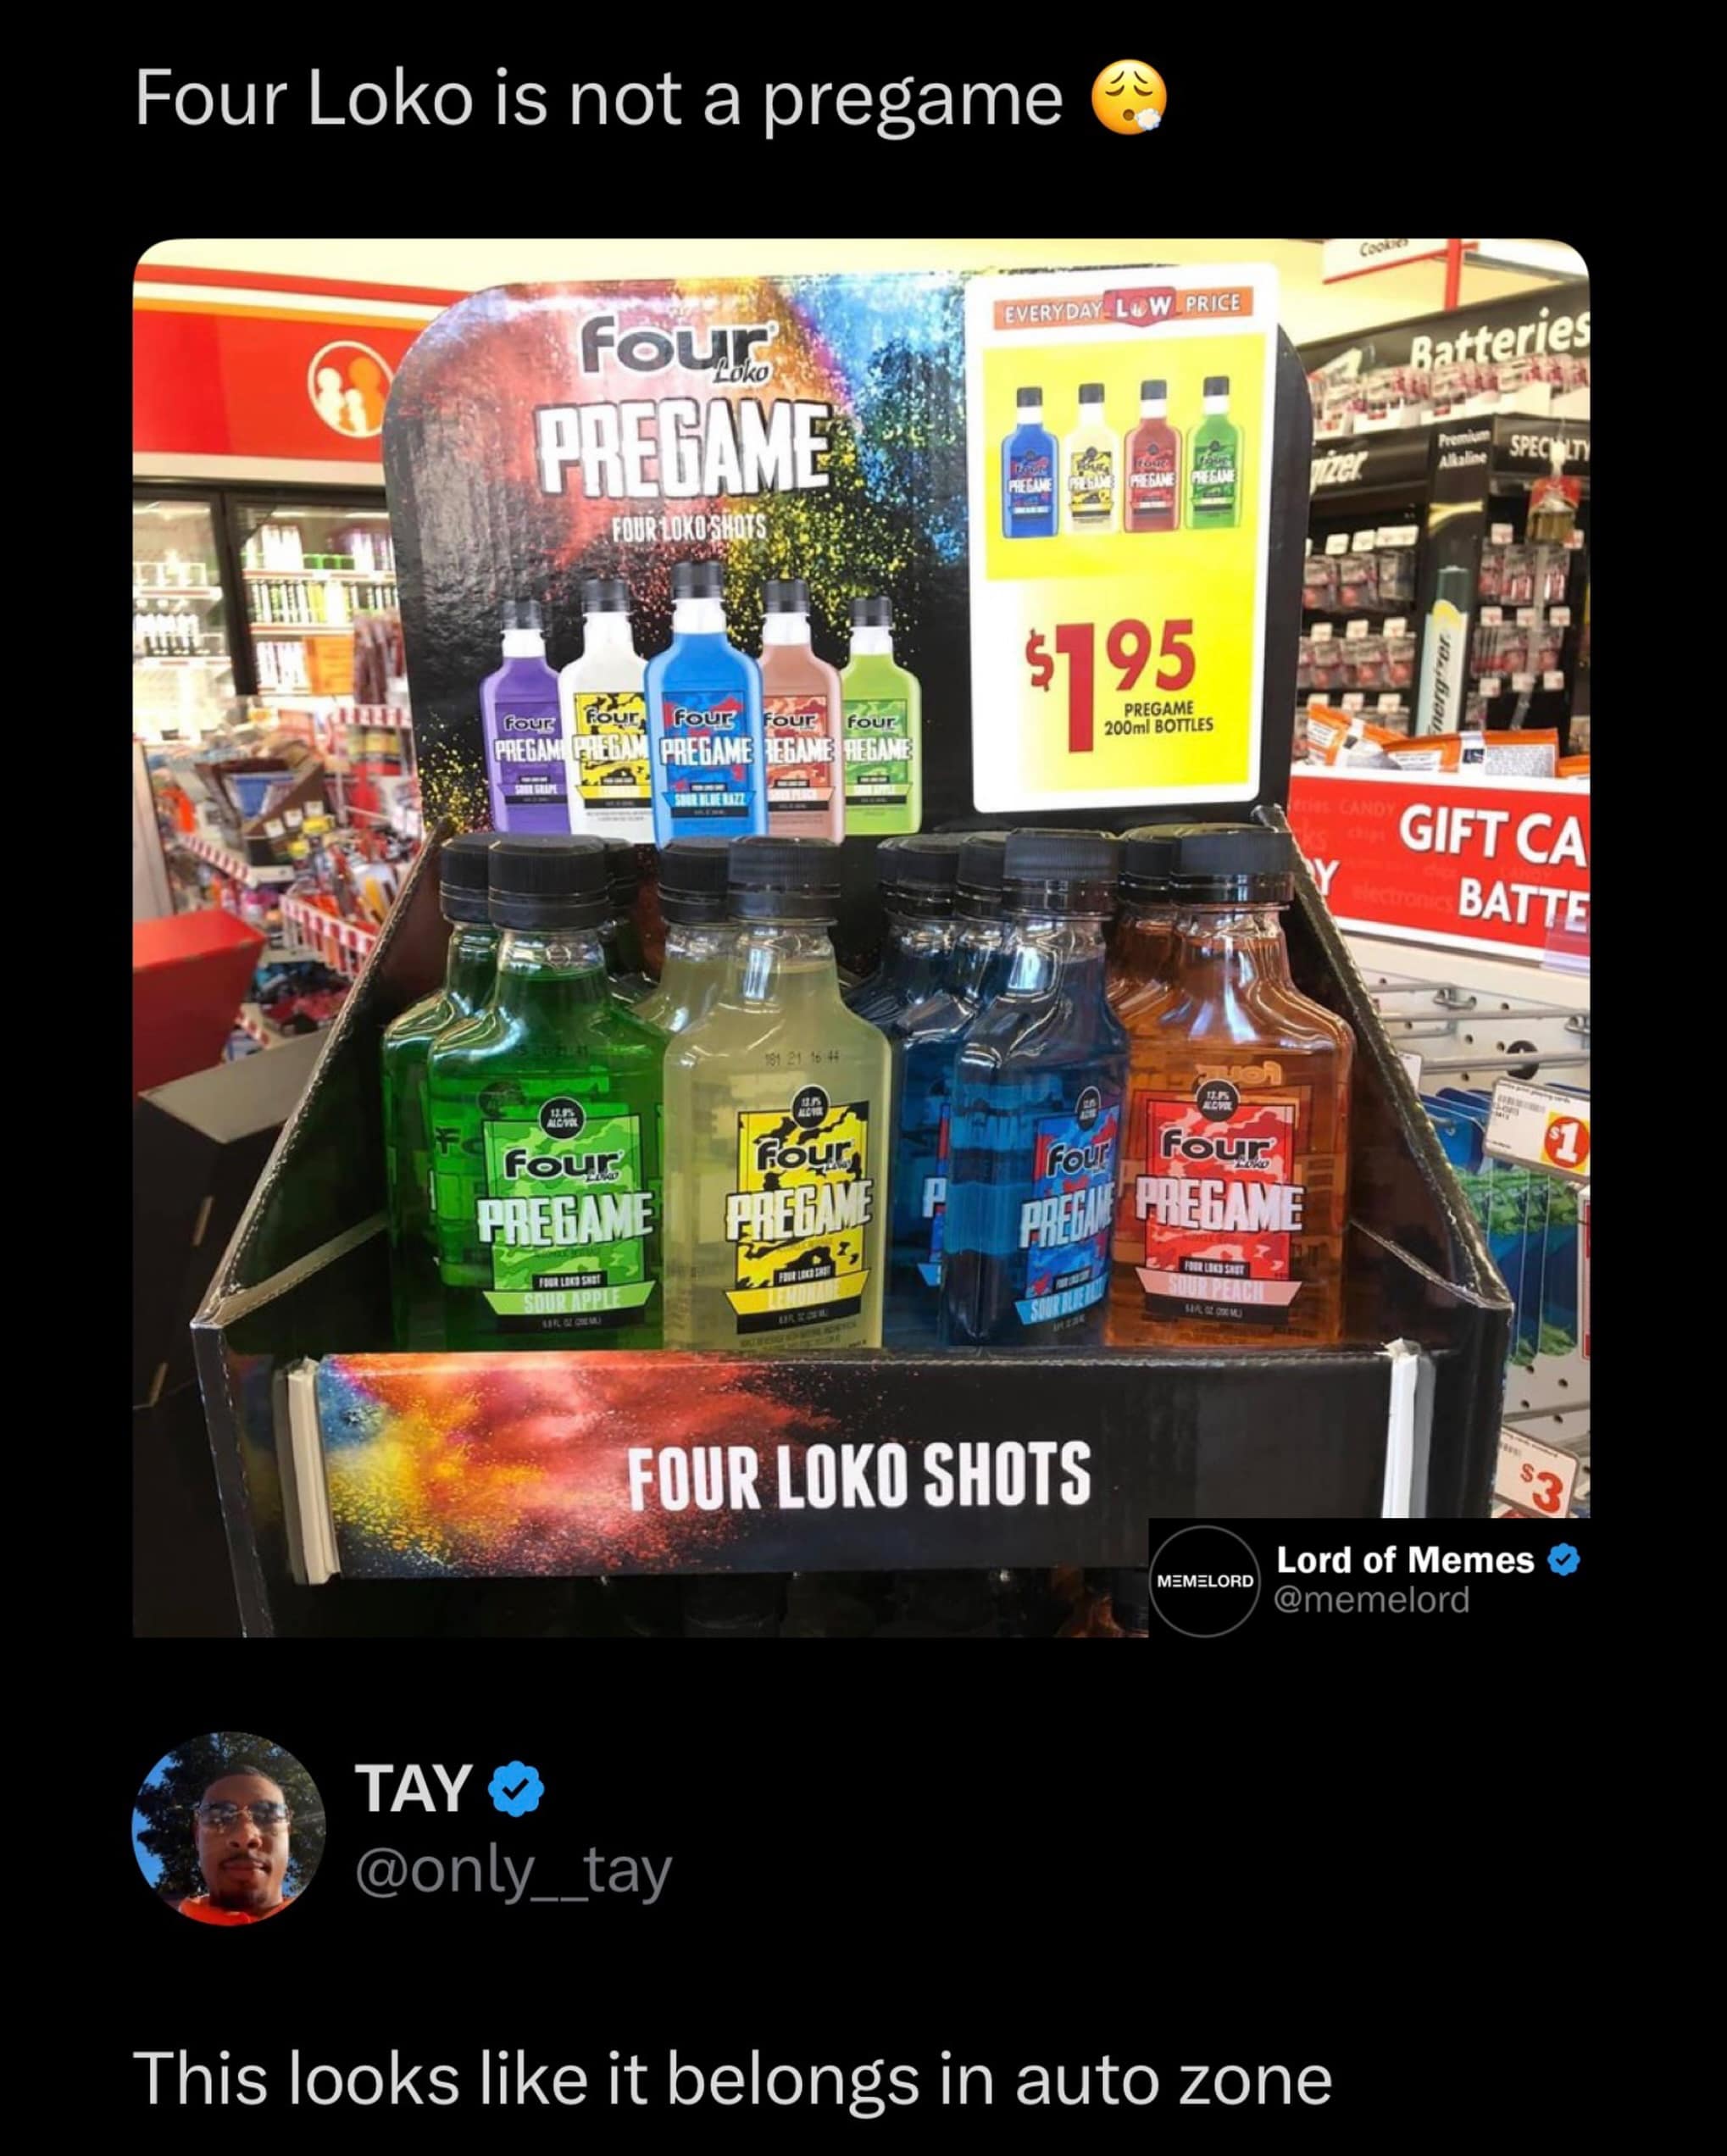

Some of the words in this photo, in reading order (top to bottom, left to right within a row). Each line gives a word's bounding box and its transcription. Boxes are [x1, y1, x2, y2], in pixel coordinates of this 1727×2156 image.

[1005, 301, 1102, 324] EVERYDAY
[1115, 297, 1172, 319] LOW
[1186, 293, 1241, 312] PRICE
[580, 314, 769, 375] four
[1411, 307, 1590, 370] Batteries
[713, 357, 769, 384] Loko
[536, 397, 831, 499] PREGAME
[1439, 428, 1491, 447] Premium
[1510, 435, 1590, 461] SPECLTY
[1439, 451, 1487, 469] Alkaline
[612, 516, 657, 542] FOUR
[663, 514, 702, 541] LOKO
[709, 514, 768, 540] SHOTS
[1124, 700, 1193, 717] PREGAME
[1104, 720, 1150, 736] 200ml
[1155, 718, 1213, 733] BOTTLES
[573, 735, 647, 761] PREGAM
[660, 736, 753, 765] PREGAME
[764, 736, 835, 764] REGAME
[846, 736, 913, 762] REGAME
[1399, 803, 1509, 859] GIFT
[1516, 813, 1588, 868] CA
[1458, 876, 1590, 932] BATTE
[1549, 1121, 1579, 1163] $1
[726, 1180, 872, 1242] PREGAME
[1019, 1182, 1115, 1248] PREGAME
[1136, 1175, 1305, 1232] PREGAME
[477, 1192, 653, 1247] PREGAME
[779, 1271, 797, 1283] FOUR
[1184, 1260, 1203, 1272] FOUR
[539, 1277, 558, 1288] FOUR
[560, 1276, 580, 1287] LOKO
[581, 1274, 602, 1285] SHOT
[1169, 1274, 1207, 1301] SOUR
[1212, 1278, 1263, 1303] PEACH
[524, 1291, 564, 1314] SOUR
[572, 1287, 620, 1313] APPLE
[628, 1446, 760, 1511] FOUR
[778, 1443, 908, 1509] LOKO
[925, 1442, 1091, 1507] SHOTS
[1520, 1463, 1563, 1514] $3
